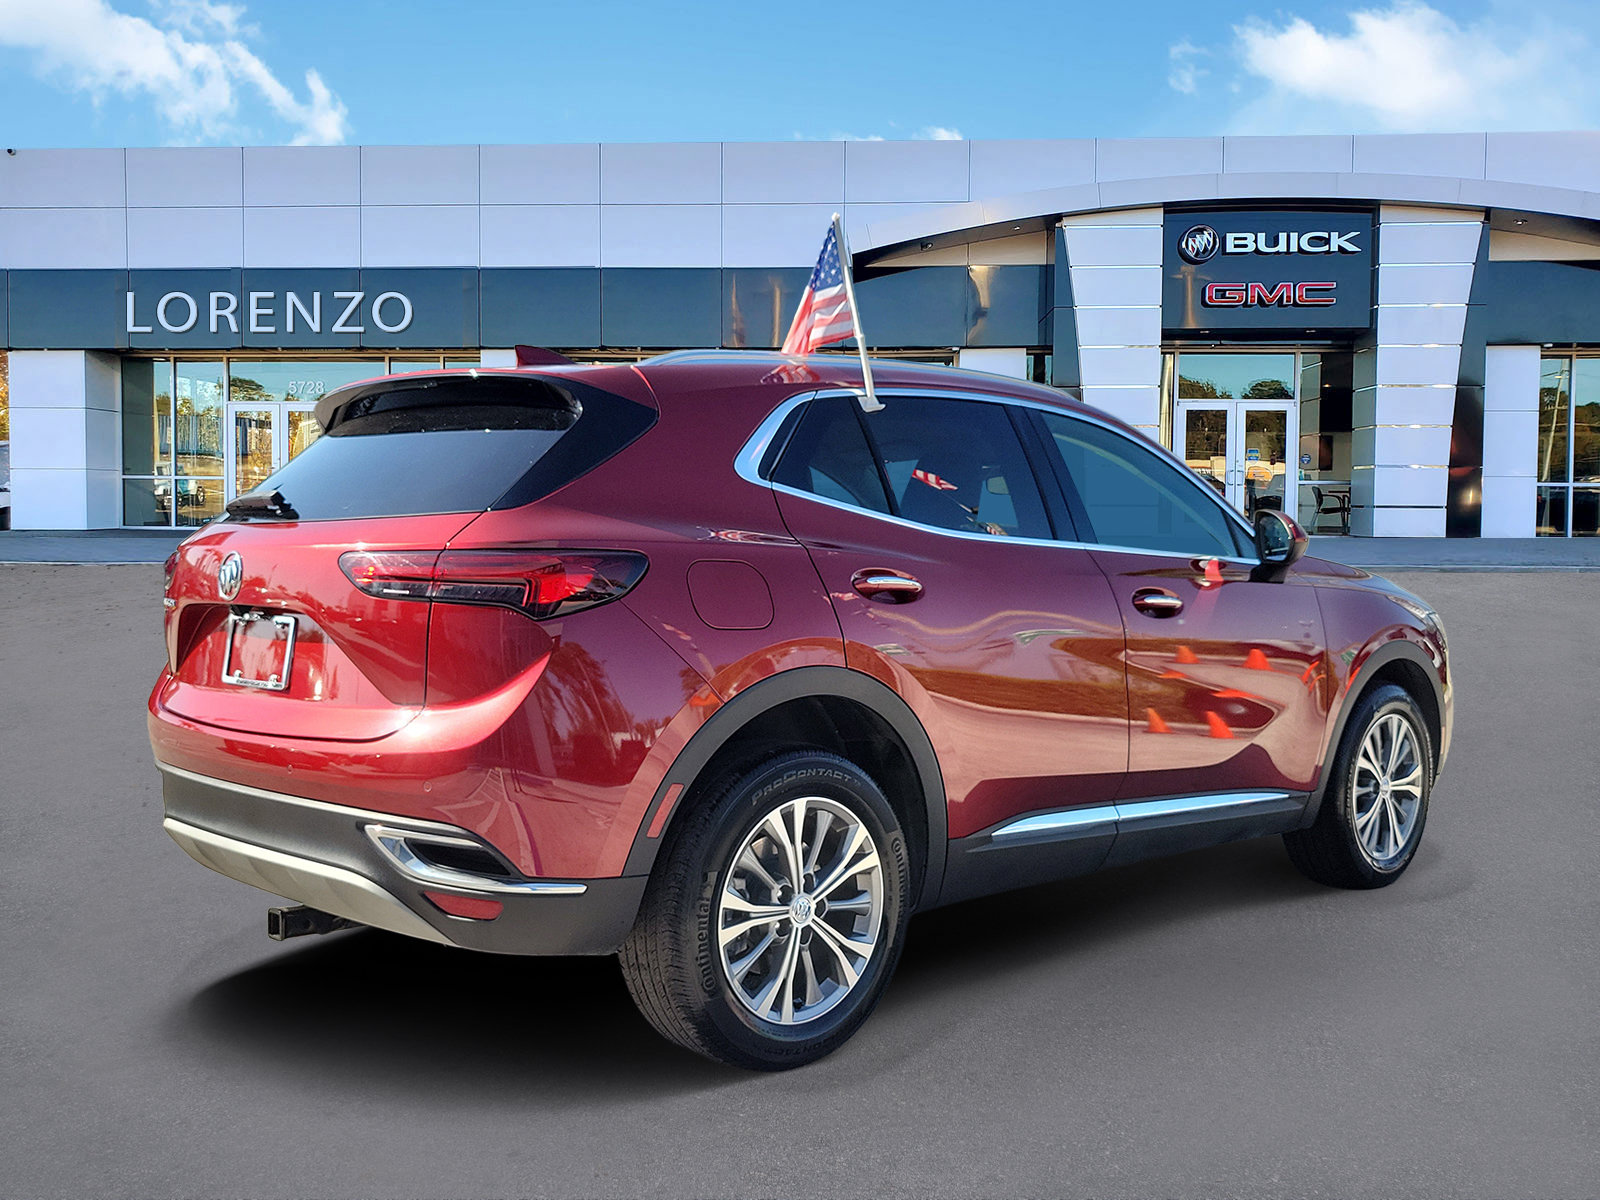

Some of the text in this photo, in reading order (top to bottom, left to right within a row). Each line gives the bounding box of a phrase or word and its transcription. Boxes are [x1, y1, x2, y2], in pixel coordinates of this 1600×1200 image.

[1225, 230, 1362, 254] BUICK
[1204, 281, 1338, 306] GMC
[126, 290, 415, 334] LORENZO
[288, 380, 325, 394] 5728
[694, 895, 719, 993] Continental
